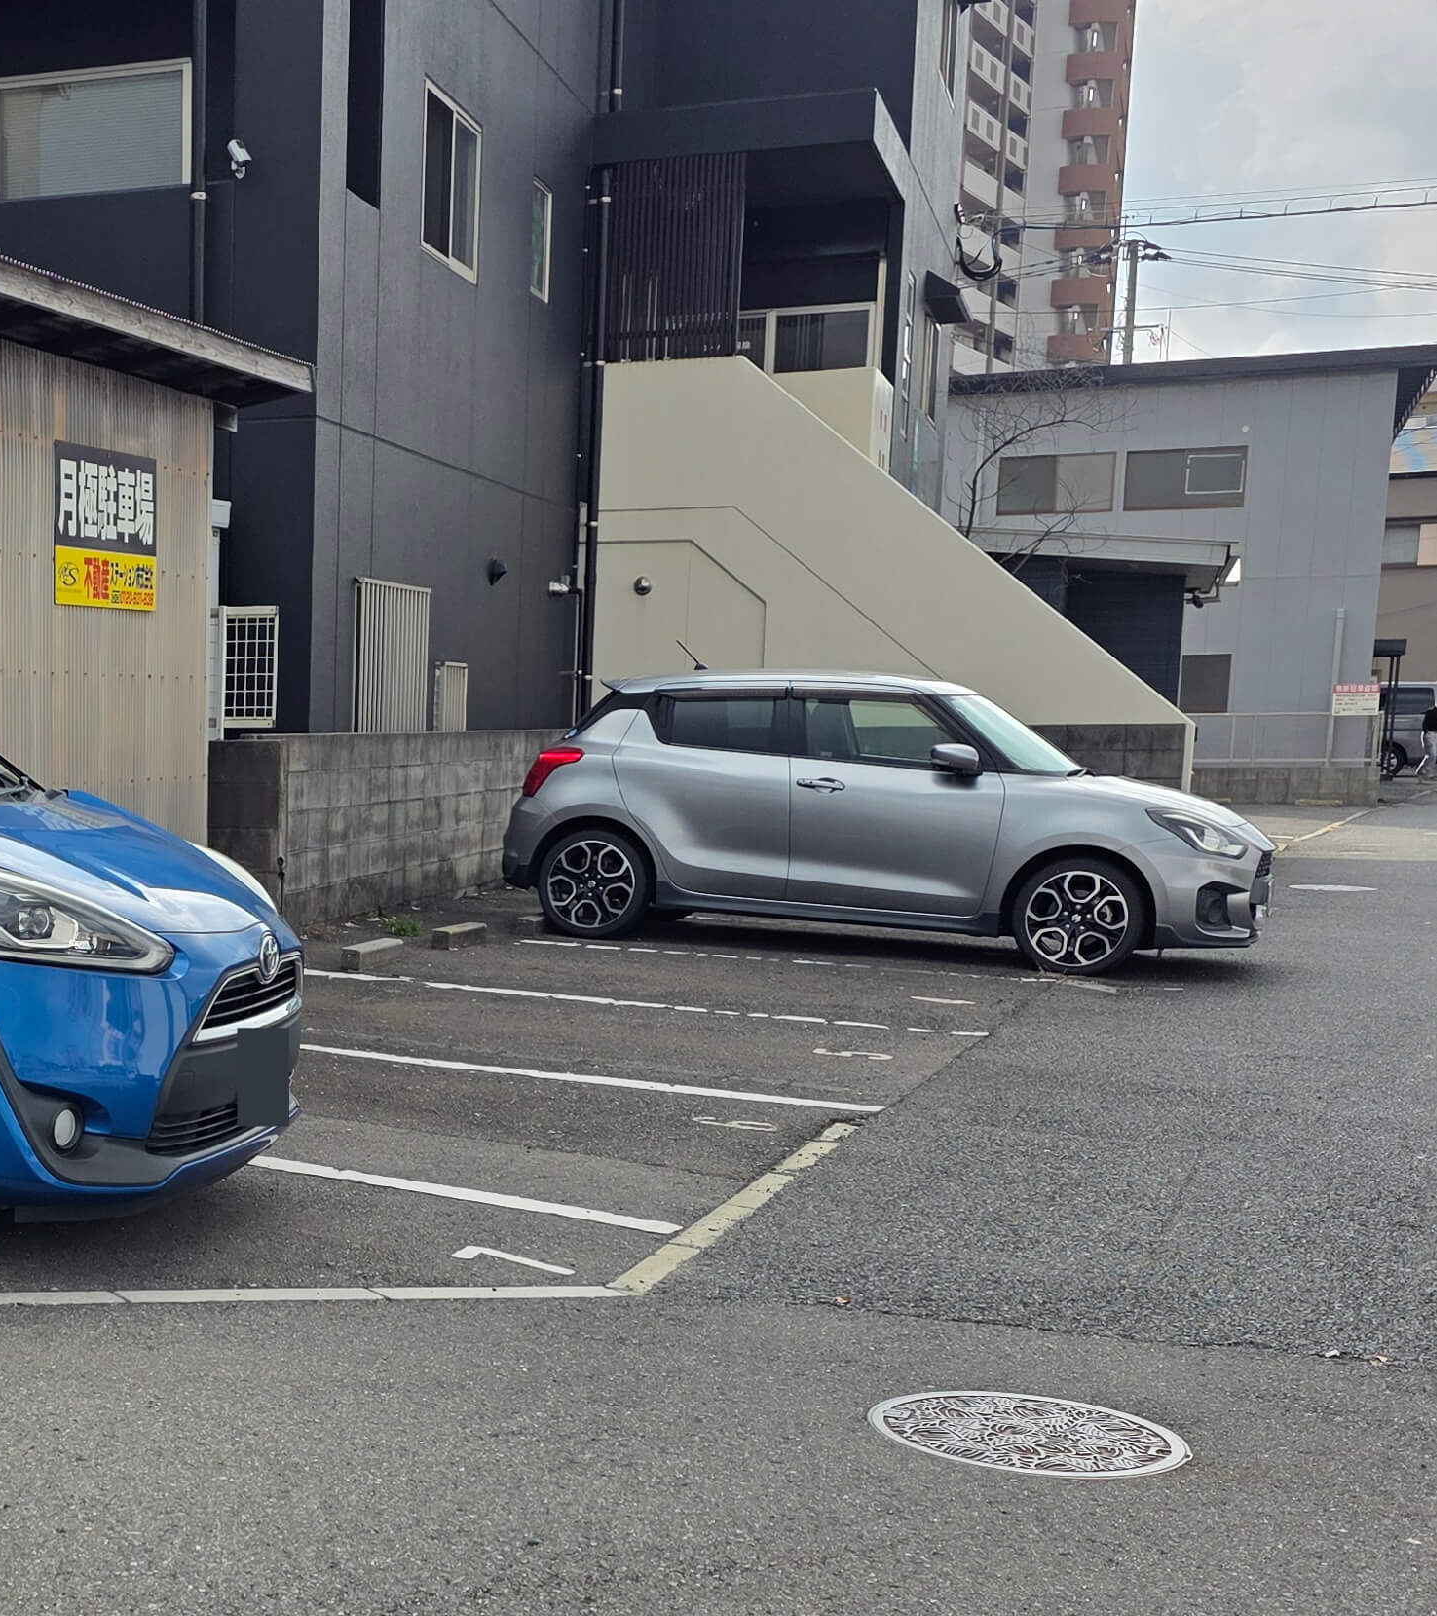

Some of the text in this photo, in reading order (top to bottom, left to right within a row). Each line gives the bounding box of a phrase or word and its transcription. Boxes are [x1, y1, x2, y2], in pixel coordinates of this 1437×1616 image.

[58, 458, 154, 545] 月極駐車場
